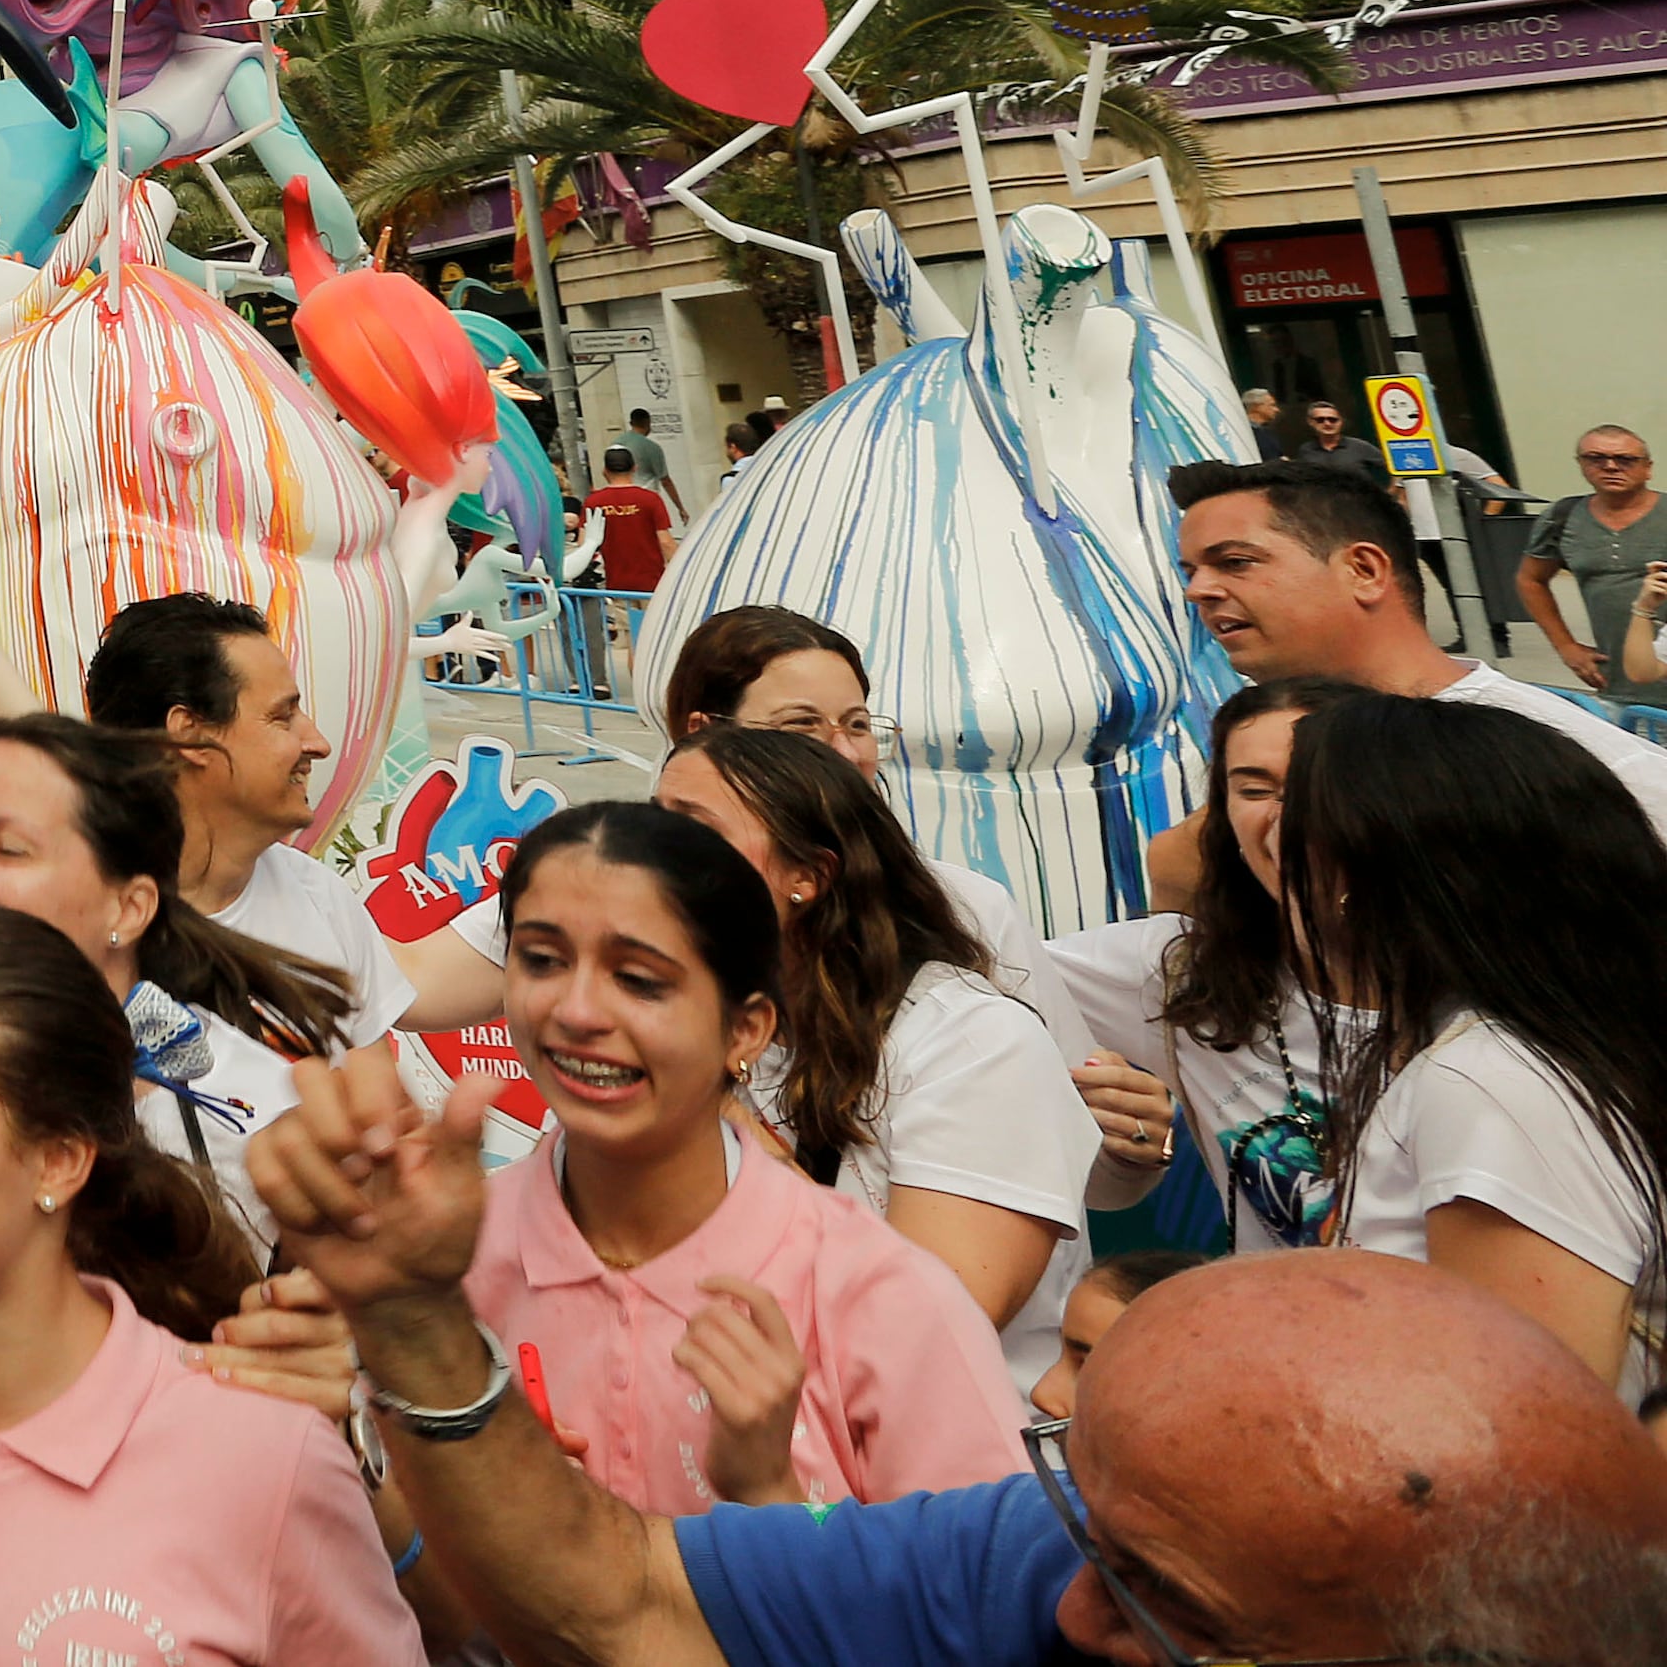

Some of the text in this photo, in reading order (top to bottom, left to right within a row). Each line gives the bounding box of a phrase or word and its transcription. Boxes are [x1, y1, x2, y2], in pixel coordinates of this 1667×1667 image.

[1420, 25, 1452, 48] DE
[1459, 13, 1563, 43] PERITOS
[1375, 42, 1549, 78] INDUSTRIALES
[1554, 37, 1591, 60] DE
[1240, 267, 1332, 286] OFICINA
[1243, 281, 1367, 303] ELECTORAL
[17, 1586, 98, 1653] BELLEZA
